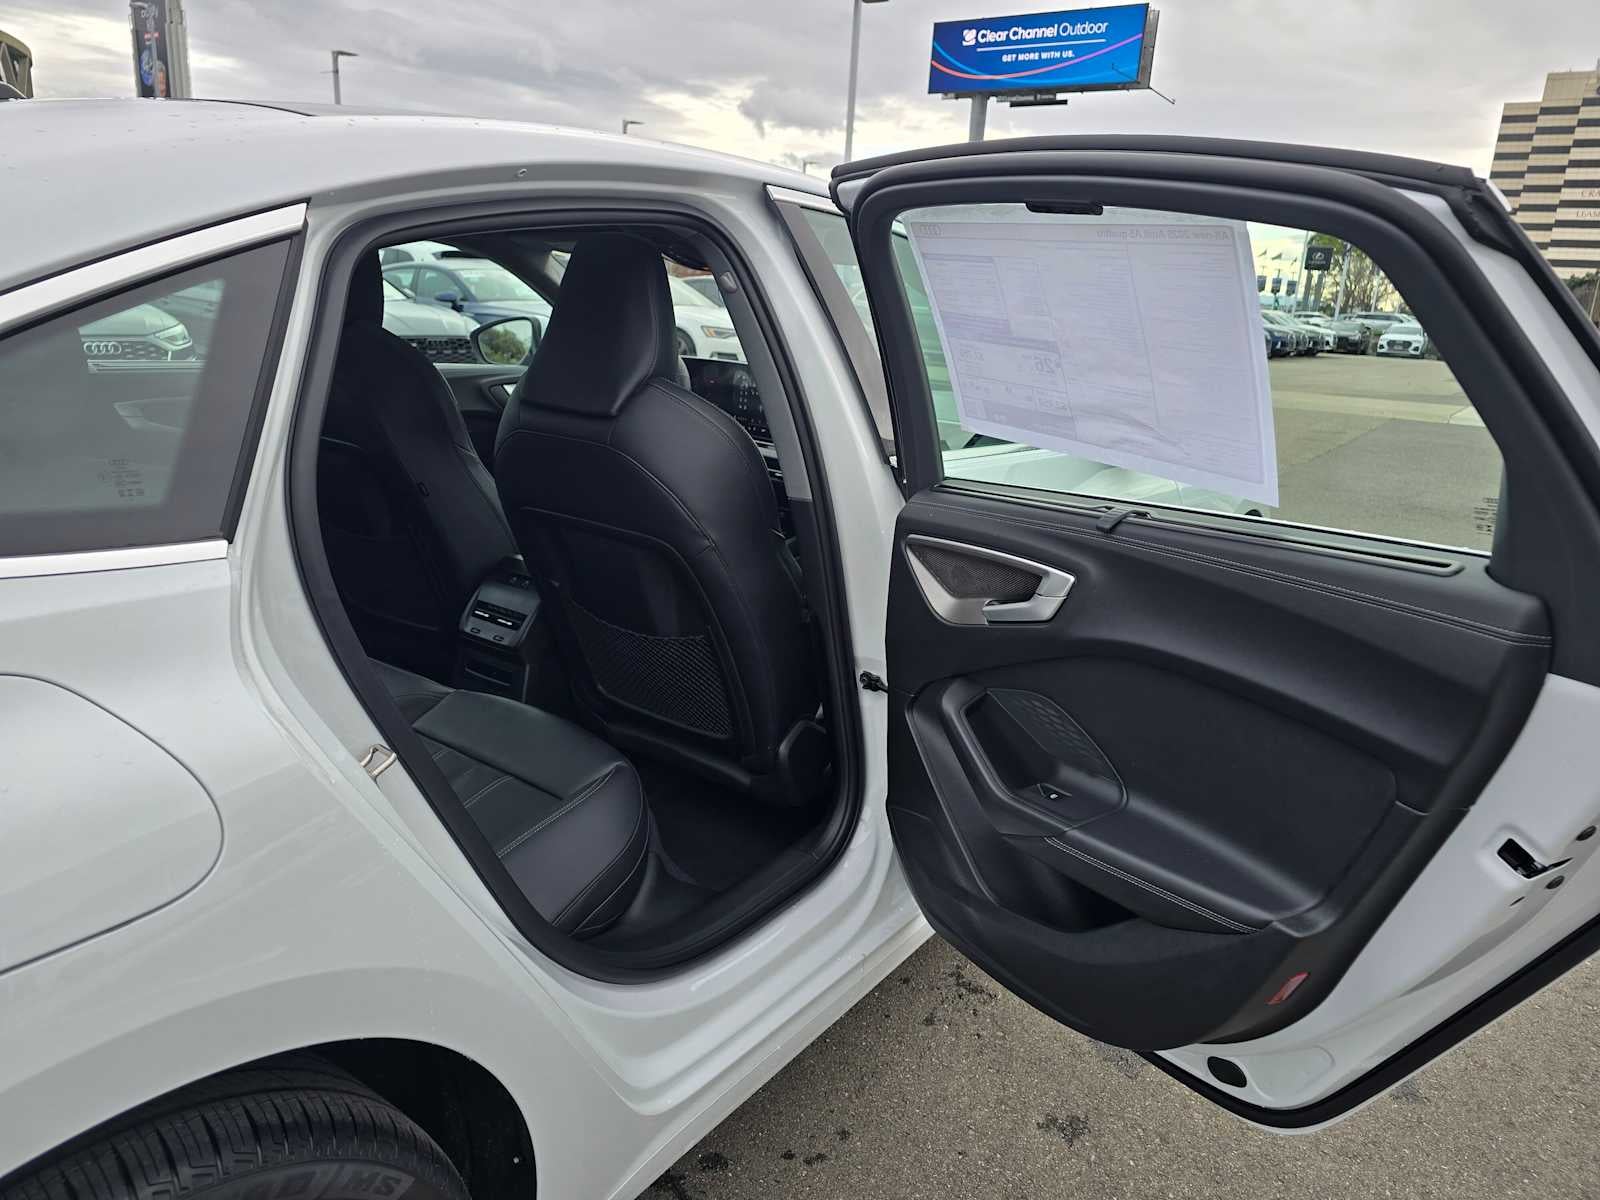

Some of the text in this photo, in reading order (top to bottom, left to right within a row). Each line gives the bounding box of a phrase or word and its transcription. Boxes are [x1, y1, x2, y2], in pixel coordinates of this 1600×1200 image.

[978, 22, 1107, 43] Clear Channel Outdoor
[1002, 53, 1016, 62] GET
[1018, 52, 1039, 61] MORE
[1041, 51, 1061, 60] WITH
